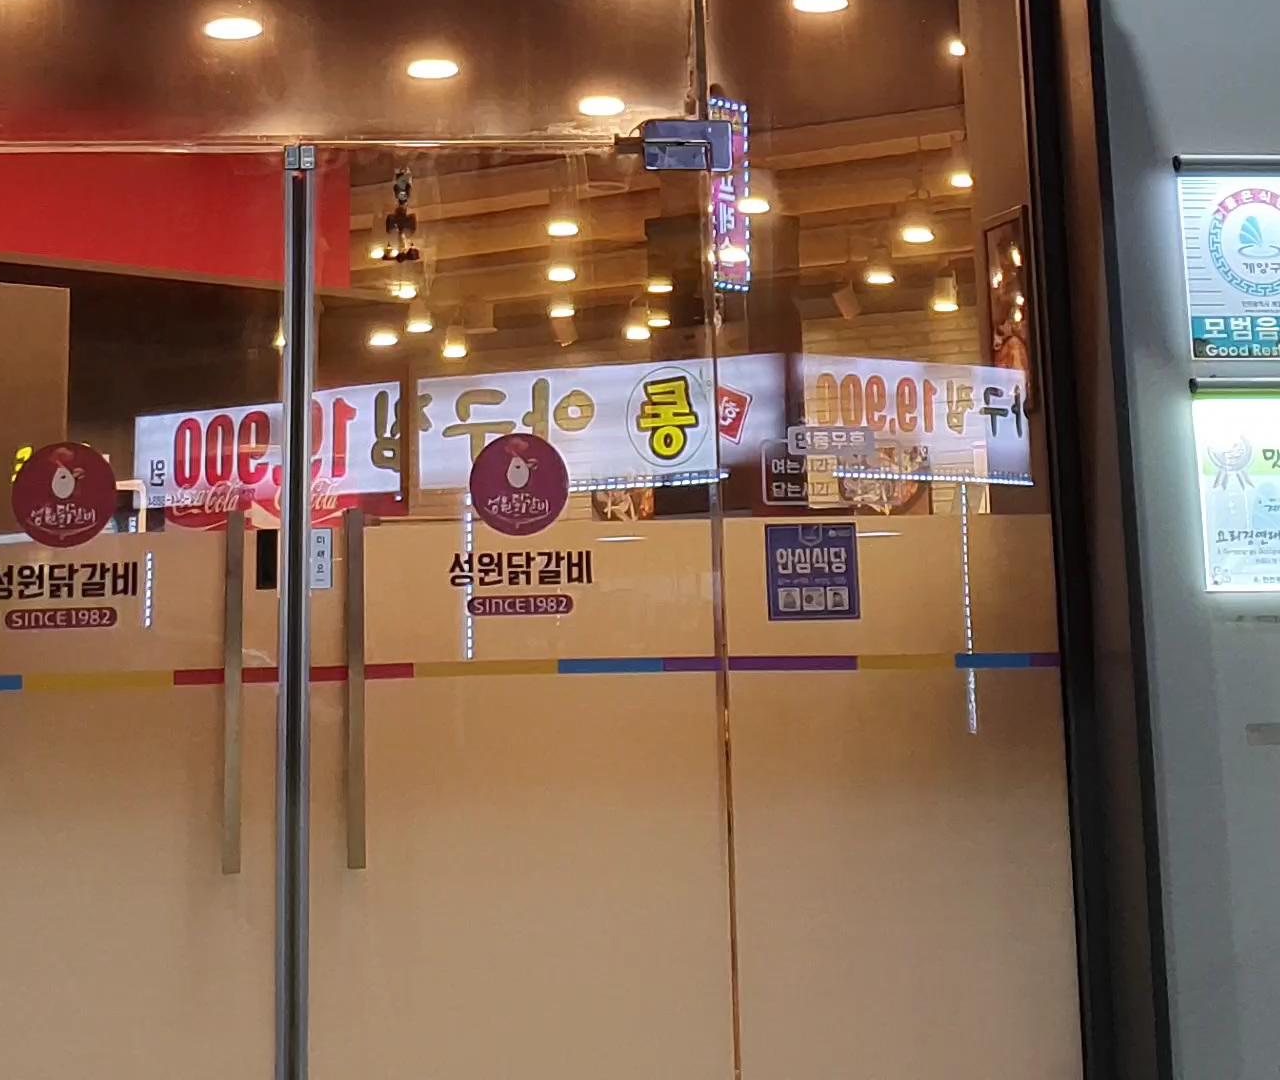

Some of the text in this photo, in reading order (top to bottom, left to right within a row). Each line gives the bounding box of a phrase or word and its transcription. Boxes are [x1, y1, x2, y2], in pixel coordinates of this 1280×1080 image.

[1205, 344, 1249, 357] Good
[449, 550, 593, 587] 성원닭갈비
[776, 547, 847, 574] 안심식당
